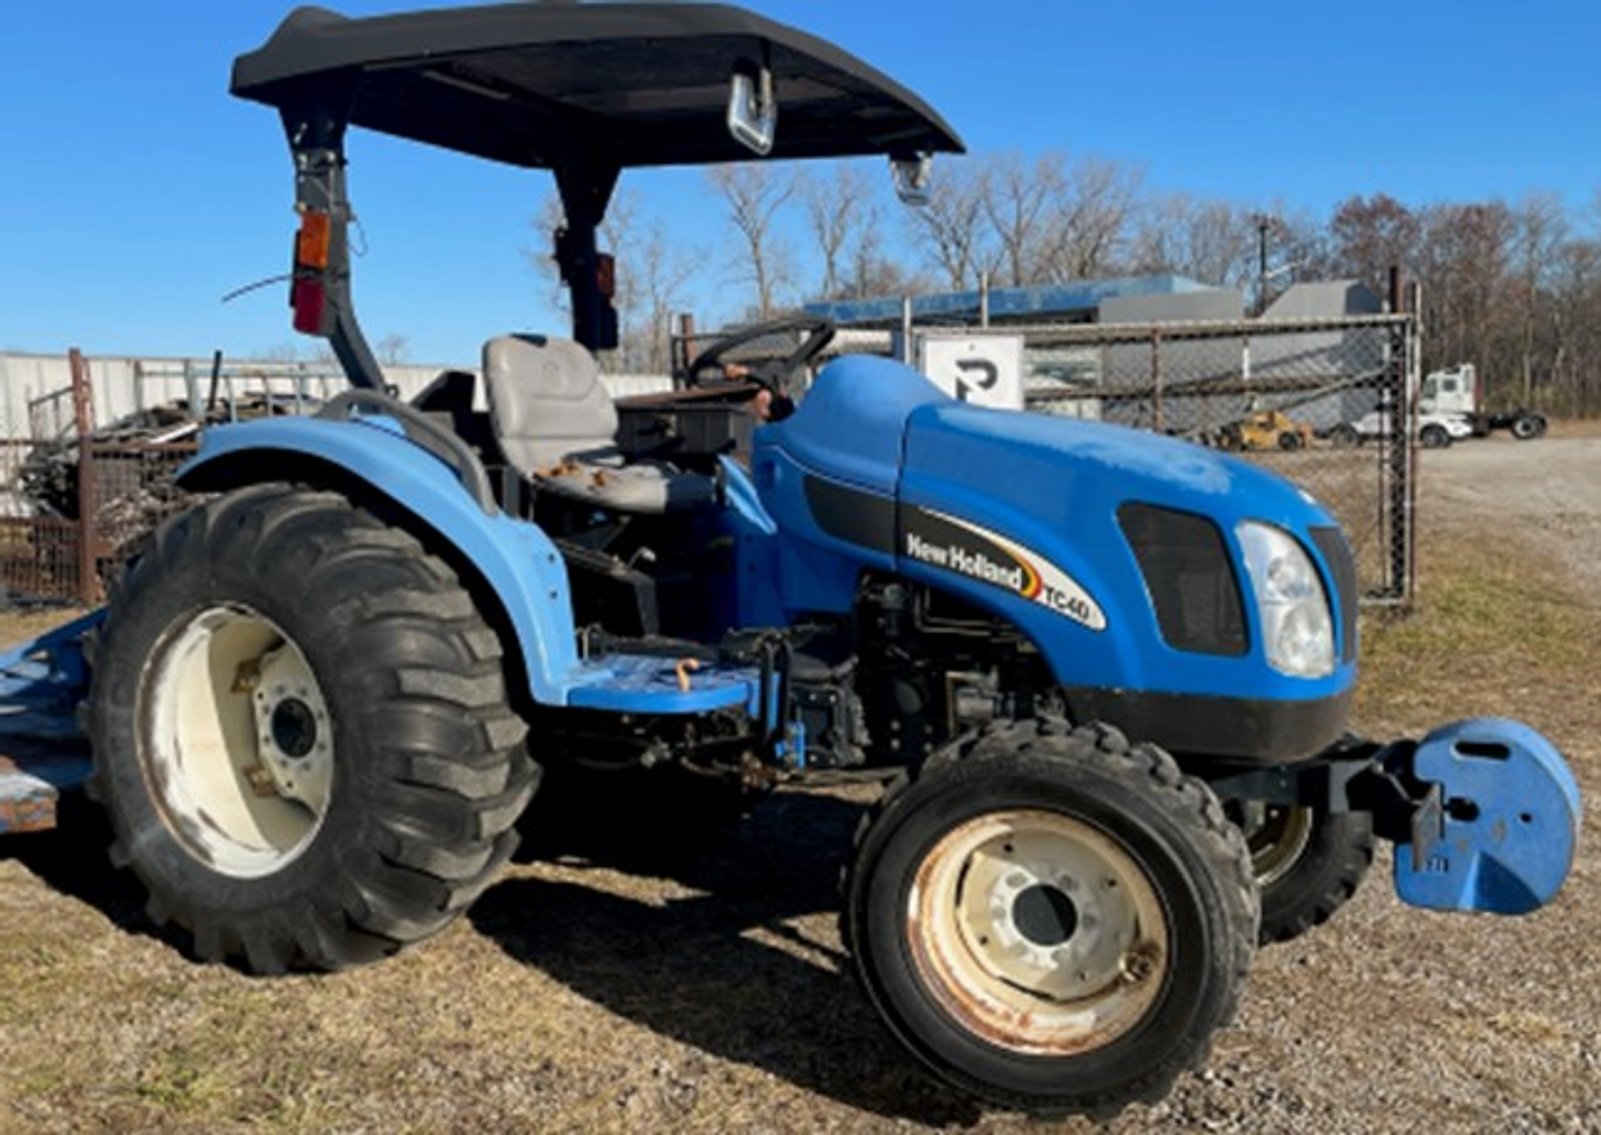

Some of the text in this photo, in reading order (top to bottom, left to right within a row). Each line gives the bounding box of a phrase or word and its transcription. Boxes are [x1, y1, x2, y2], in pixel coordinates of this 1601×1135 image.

[906, 532, 1022, 590] New Holland
[1044, 586, 1089, 620] TC40
